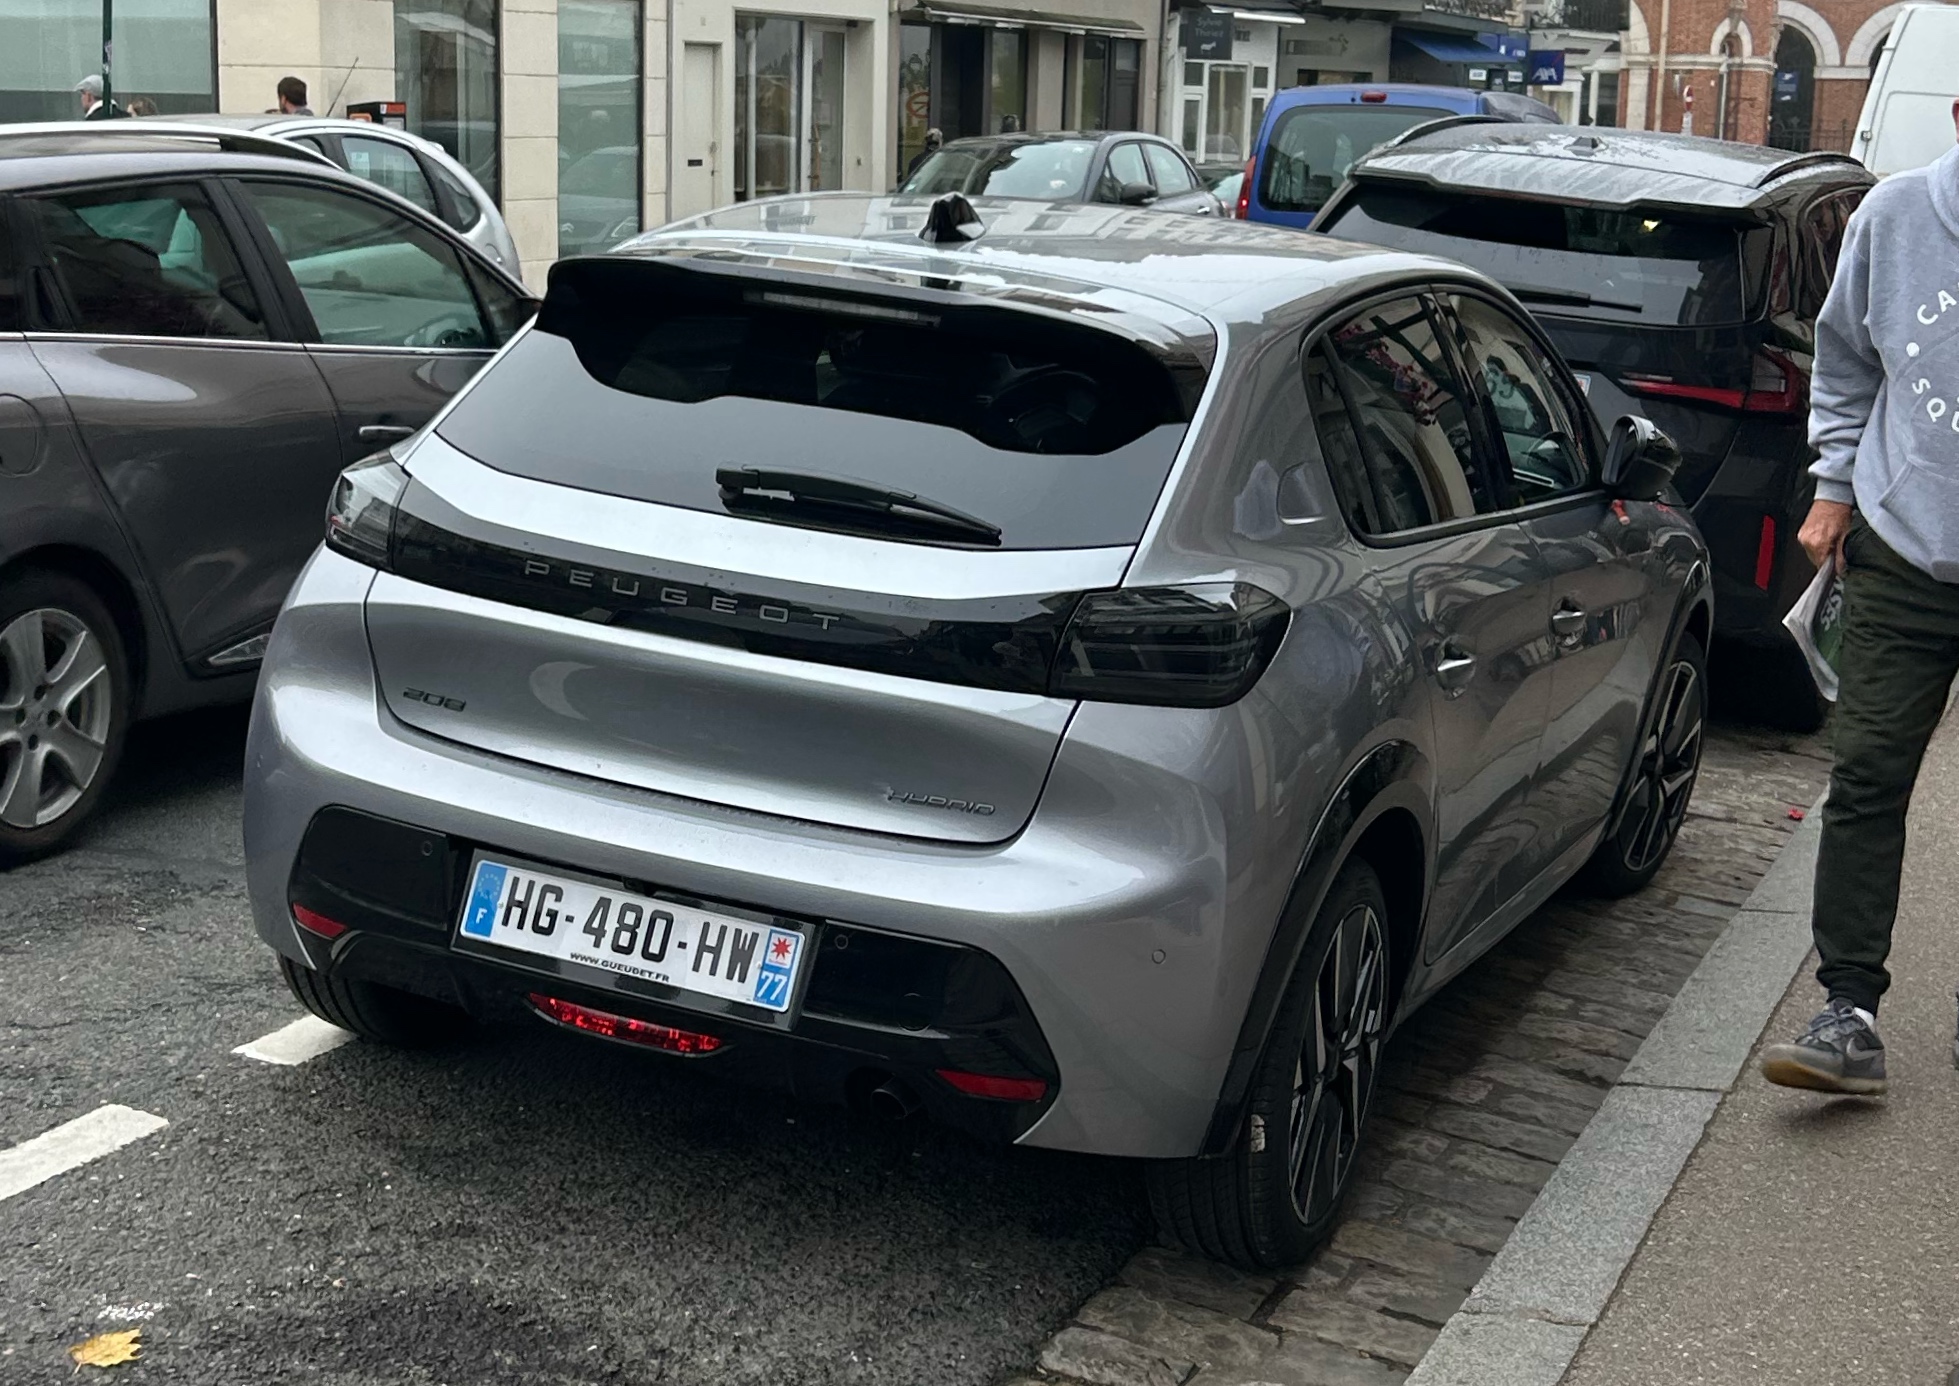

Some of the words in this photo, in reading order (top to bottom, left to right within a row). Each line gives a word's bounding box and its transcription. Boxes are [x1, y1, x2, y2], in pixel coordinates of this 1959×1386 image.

[1916, 281, 1959, 325] CA
[524, 559, 840, 631] PEUGEOT
[402, 686, 467, 713] 208
[884, 786, 996, 816] HYBRID
[475, 907, 488, 924] F
[501, 876, 760, 984] HG-480-HW
[756, 969, 788, 1001] 77
